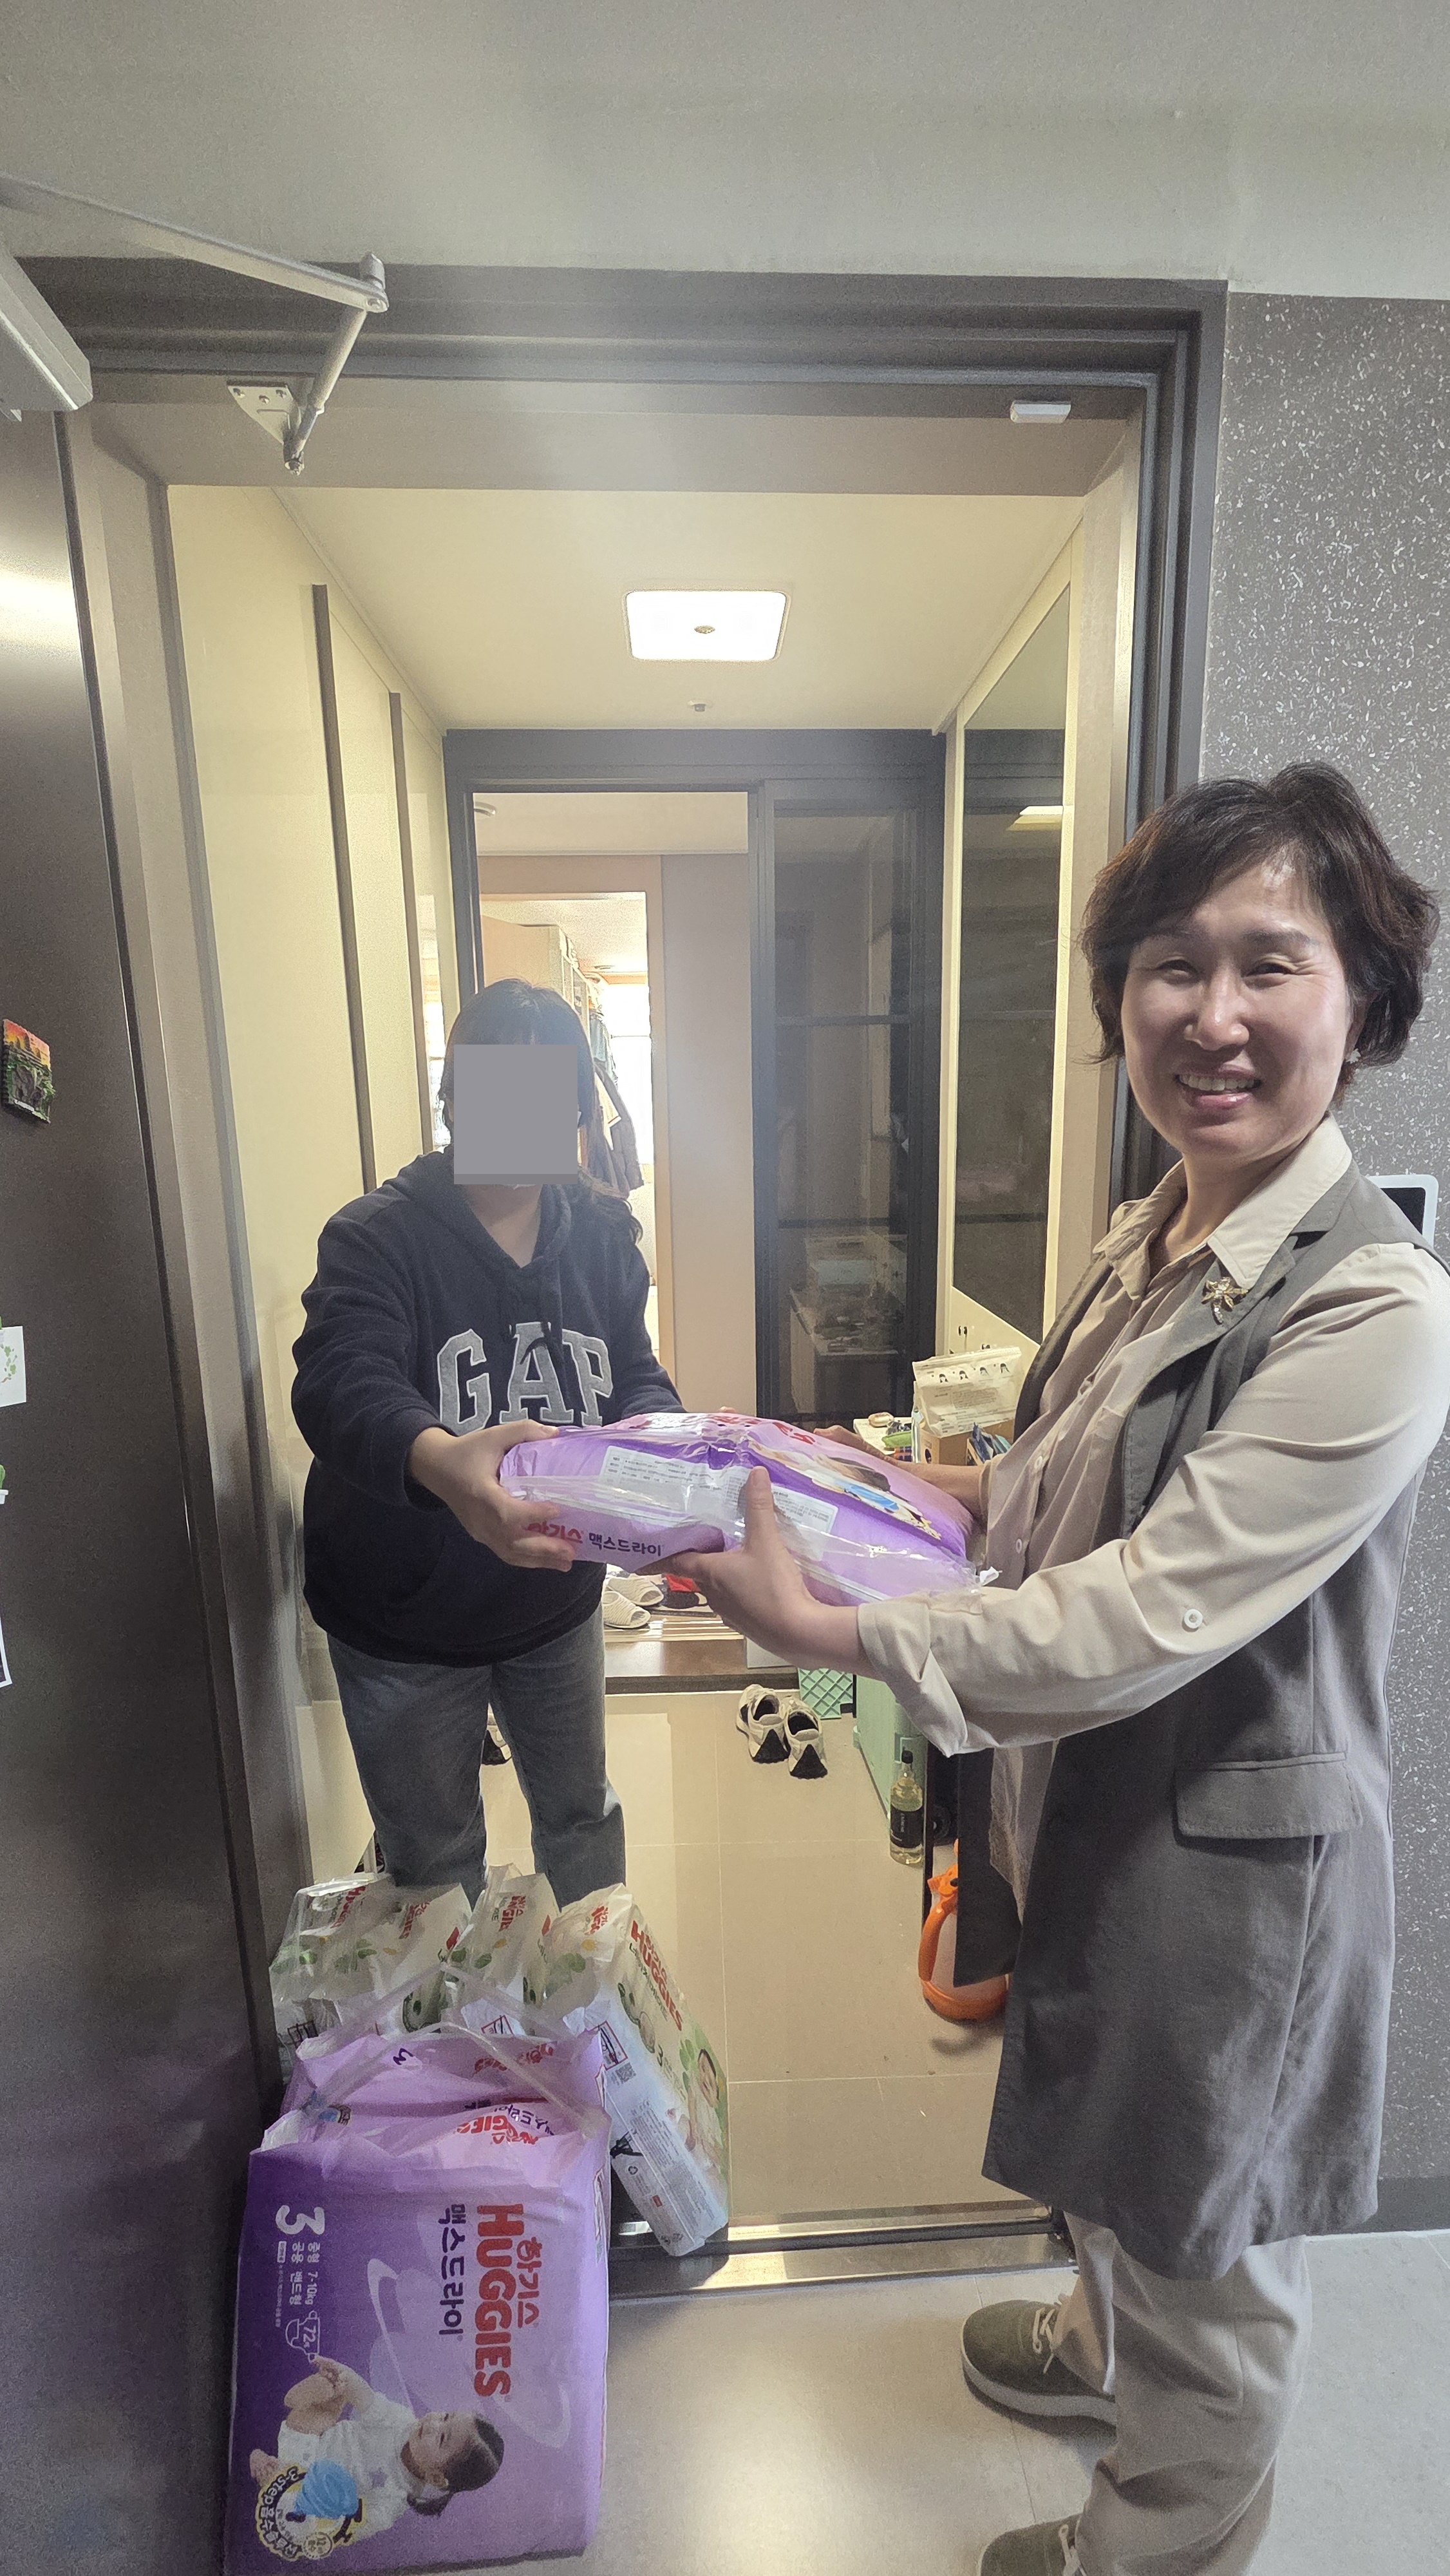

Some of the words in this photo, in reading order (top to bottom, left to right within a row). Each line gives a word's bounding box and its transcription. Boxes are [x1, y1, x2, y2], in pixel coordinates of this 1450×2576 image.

[437, 1321, 613, 1435] GAP
[588, 1533, 661, 1557] 맥스드라이
[631, 1920, 683, 2031] HUGGIES
[275, 2204, 325, 2235] 3
[290, 2241, 305, 2264] 공용
[438, 2204, 466, 2335] 맥스드라이
[516, 2236, 543, 2329] 하기스
[288, 2271, 303, 2306] 밴드형
[304, 2271, 319, 2306] 7-10kg
[473, 2203, 525, 2398] HUGGIES
